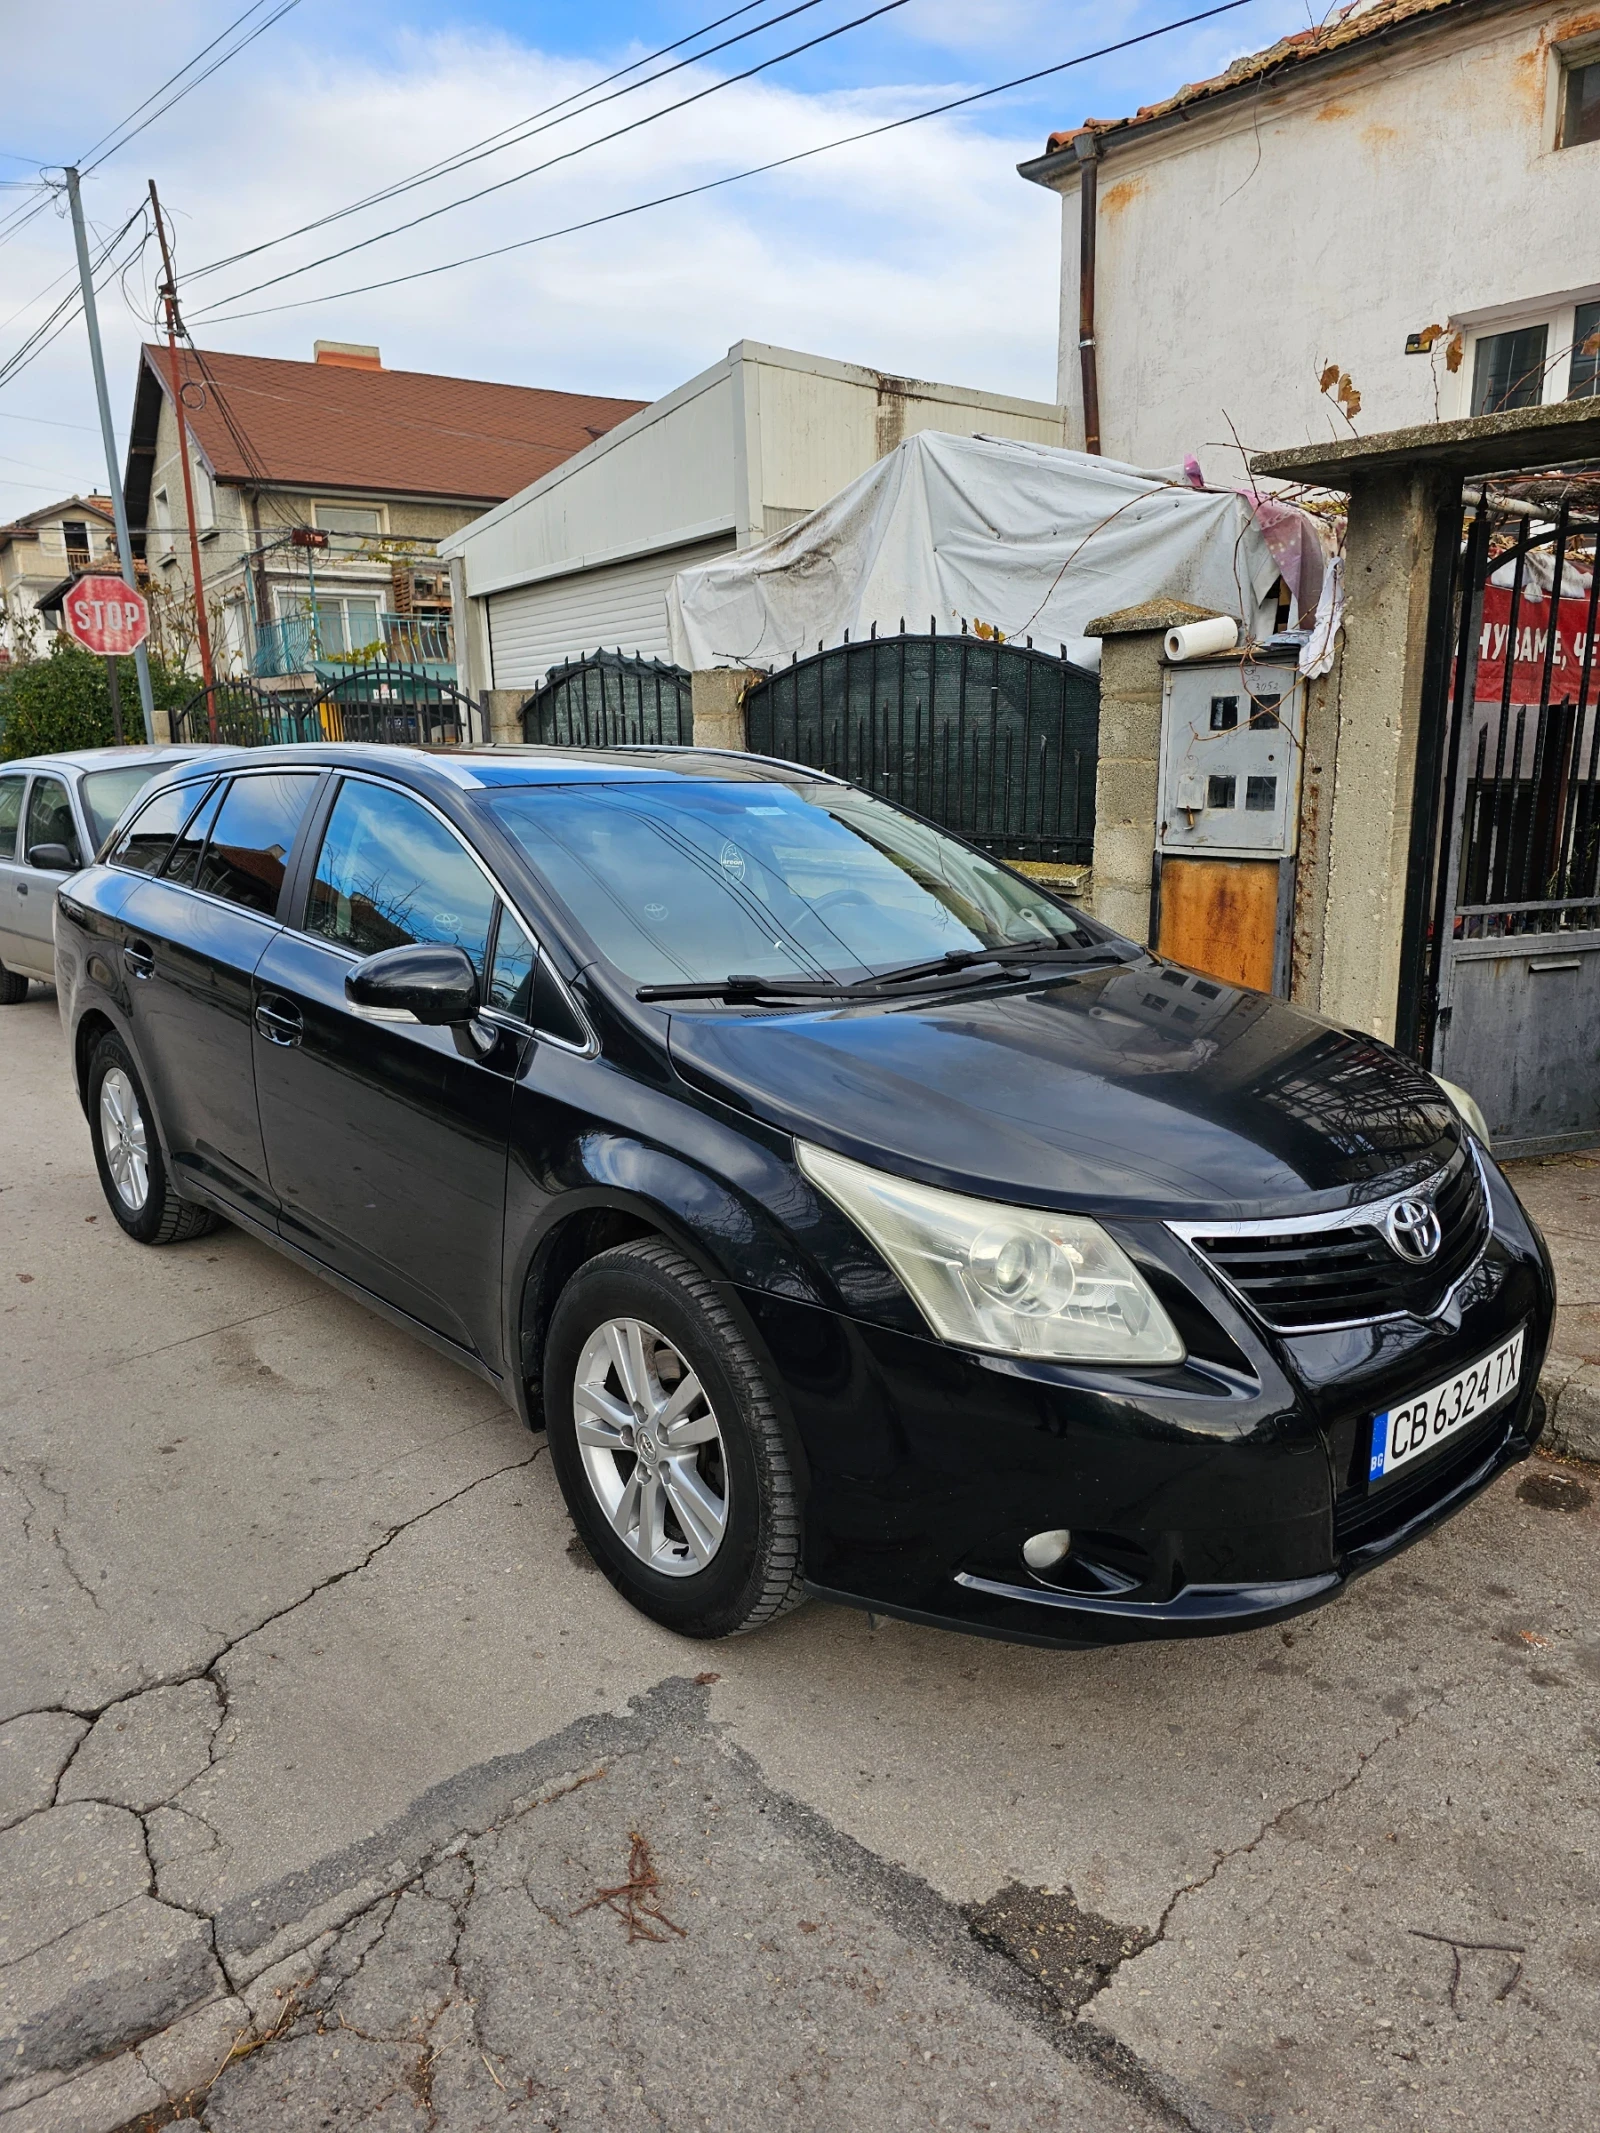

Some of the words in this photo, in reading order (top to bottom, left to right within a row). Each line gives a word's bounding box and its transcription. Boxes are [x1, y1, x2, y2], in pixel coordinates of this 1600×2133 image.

[74, 600, 140, 631] STOP
[1454, 622, 1567, 671] НУВАМЕ,
[1573, 632, 1600, 667] ЧЕ
[1391, 1401, 1428, 1459] CB
[1433, 1360, 1491, 1435] 6324
[1497, 1338, 1520, 1394] TX
[1370, 1453, 1384, 1471] BG
